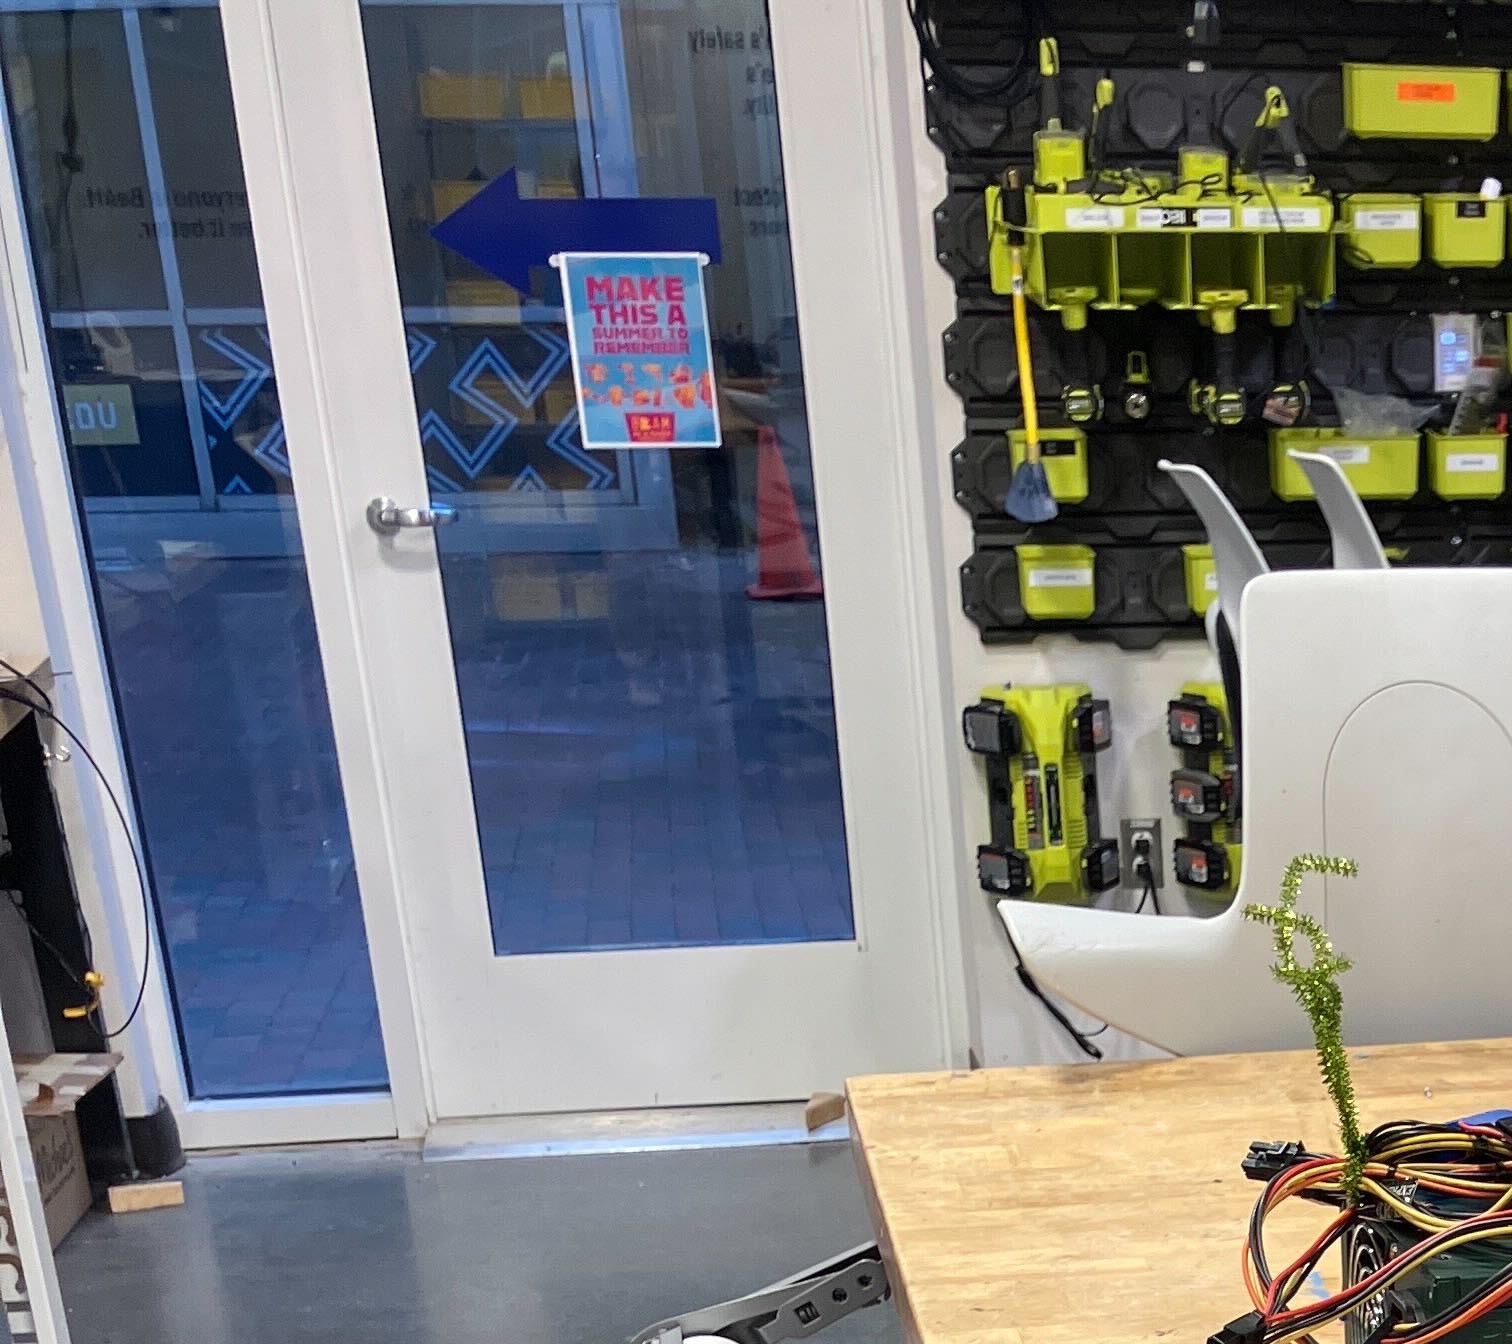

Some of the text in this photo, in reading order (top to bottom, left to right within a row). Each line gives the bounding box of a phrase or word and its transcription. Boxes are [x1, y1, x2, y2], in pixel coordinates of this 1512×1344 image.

[586, 277, 684, 301] MAKE
[591, 304, 687, 326] THIS A
[593, 327, 689, 340] SUMMER TO
[594, 342, 689, 354] REMEMBER
